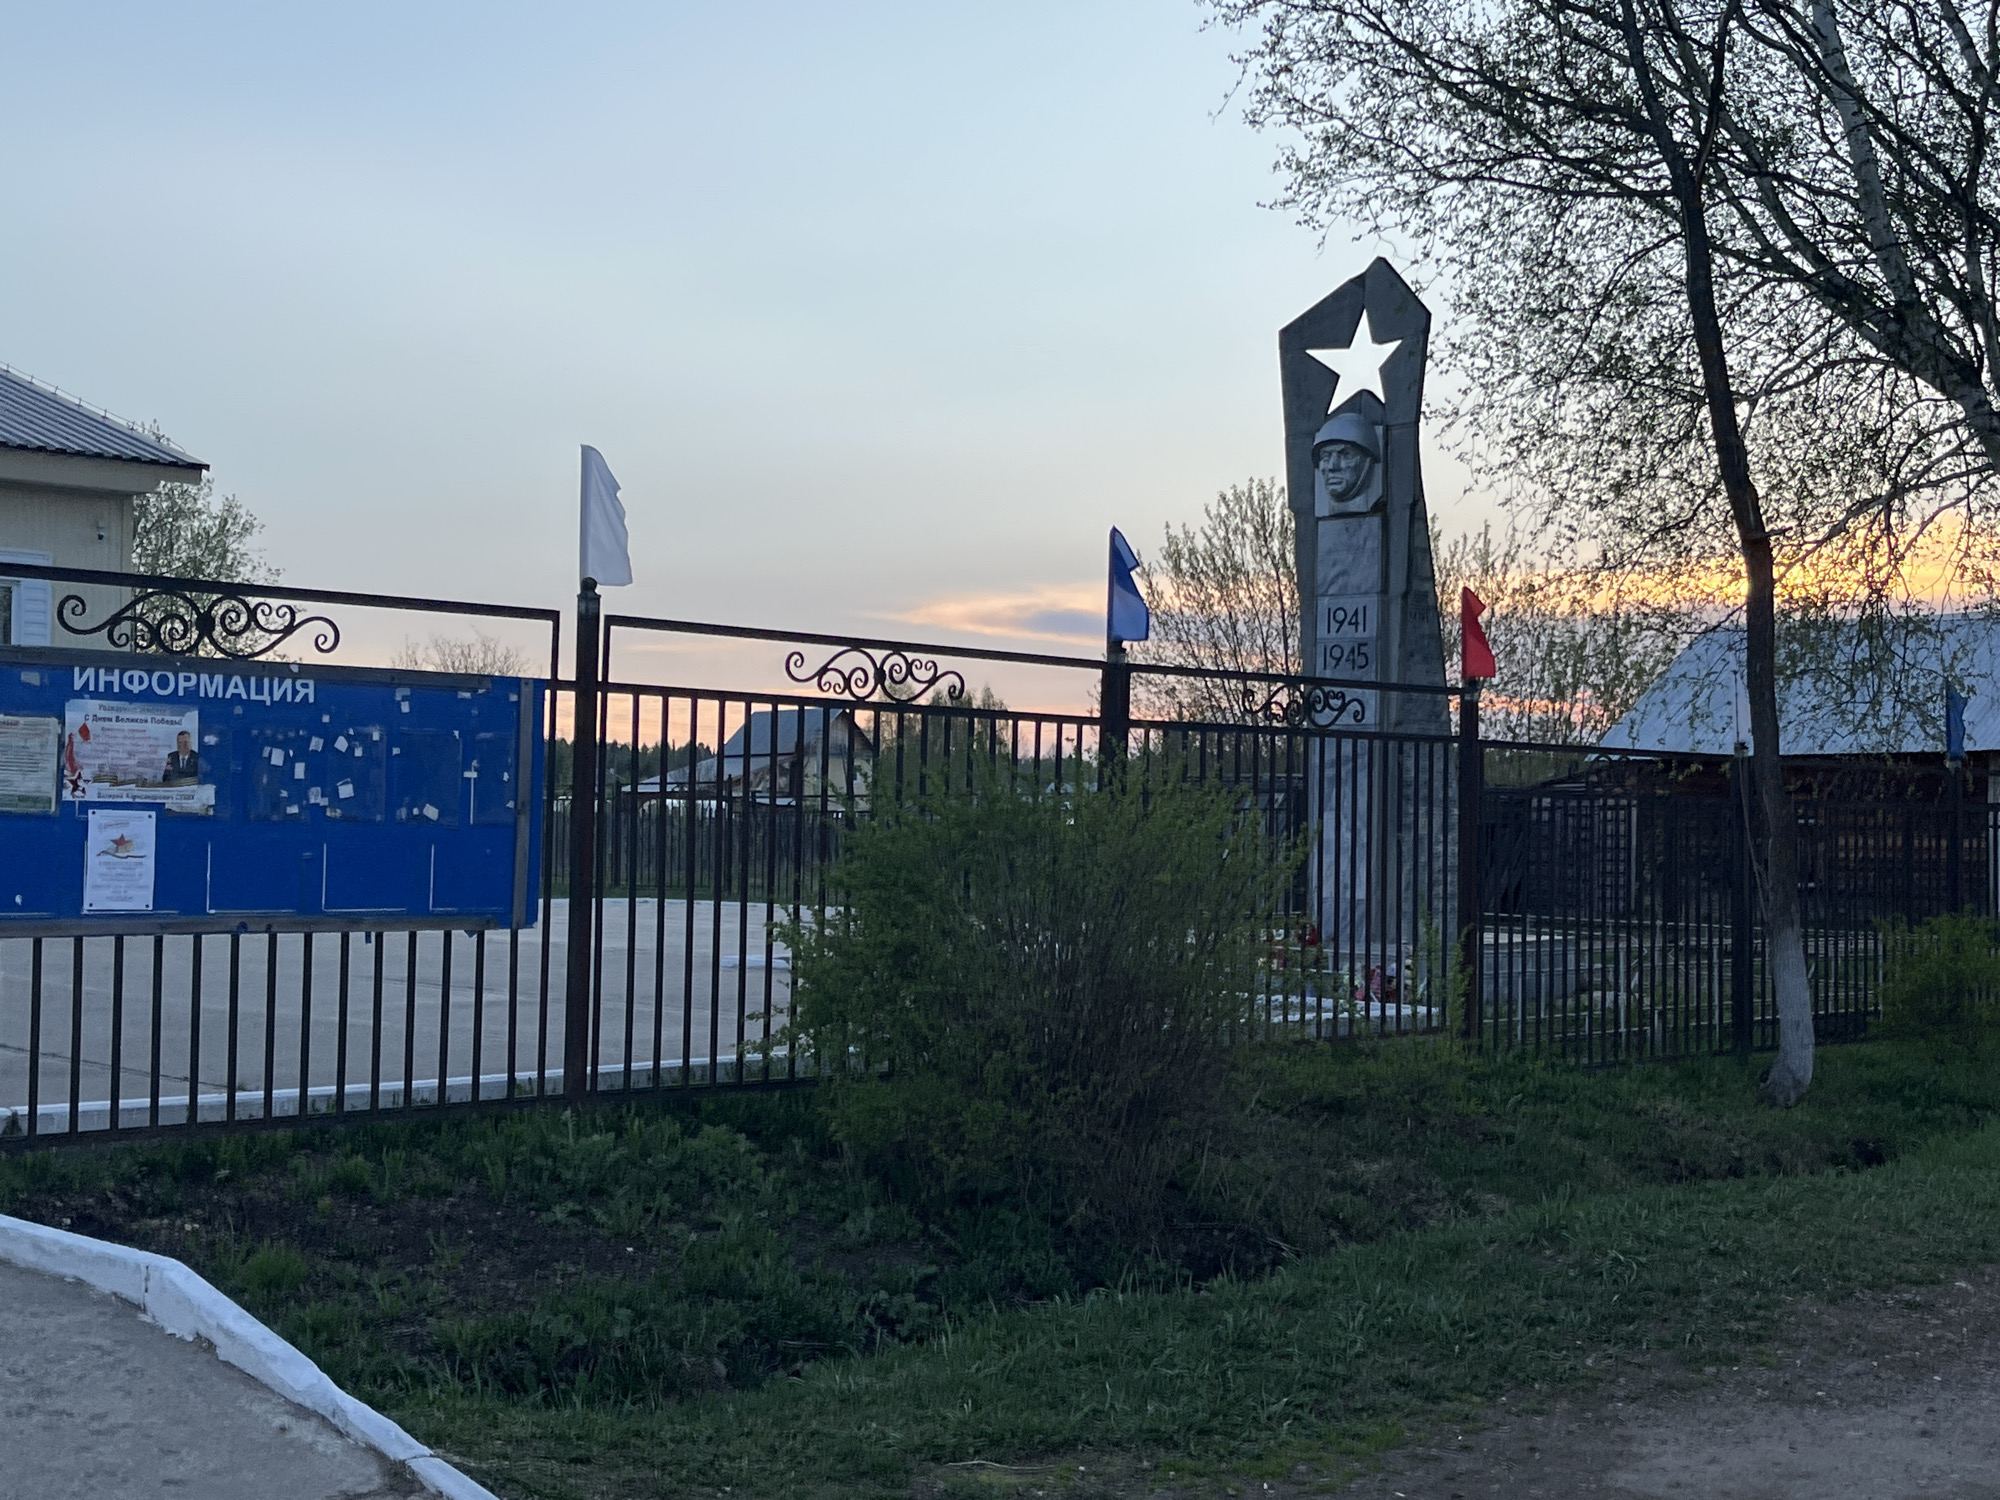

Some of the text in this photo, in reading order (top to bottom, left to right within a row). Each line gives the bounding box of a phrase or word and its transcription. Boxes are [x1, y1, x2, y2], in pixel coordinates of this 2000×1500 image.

[1327, 605, 1367, 634] 1941
[1323, 642, 1369, 670] 1945
[73, 666, 315, 705] ИНФОРМАЦИЯ
[115, 715, 149, 724] Великой
